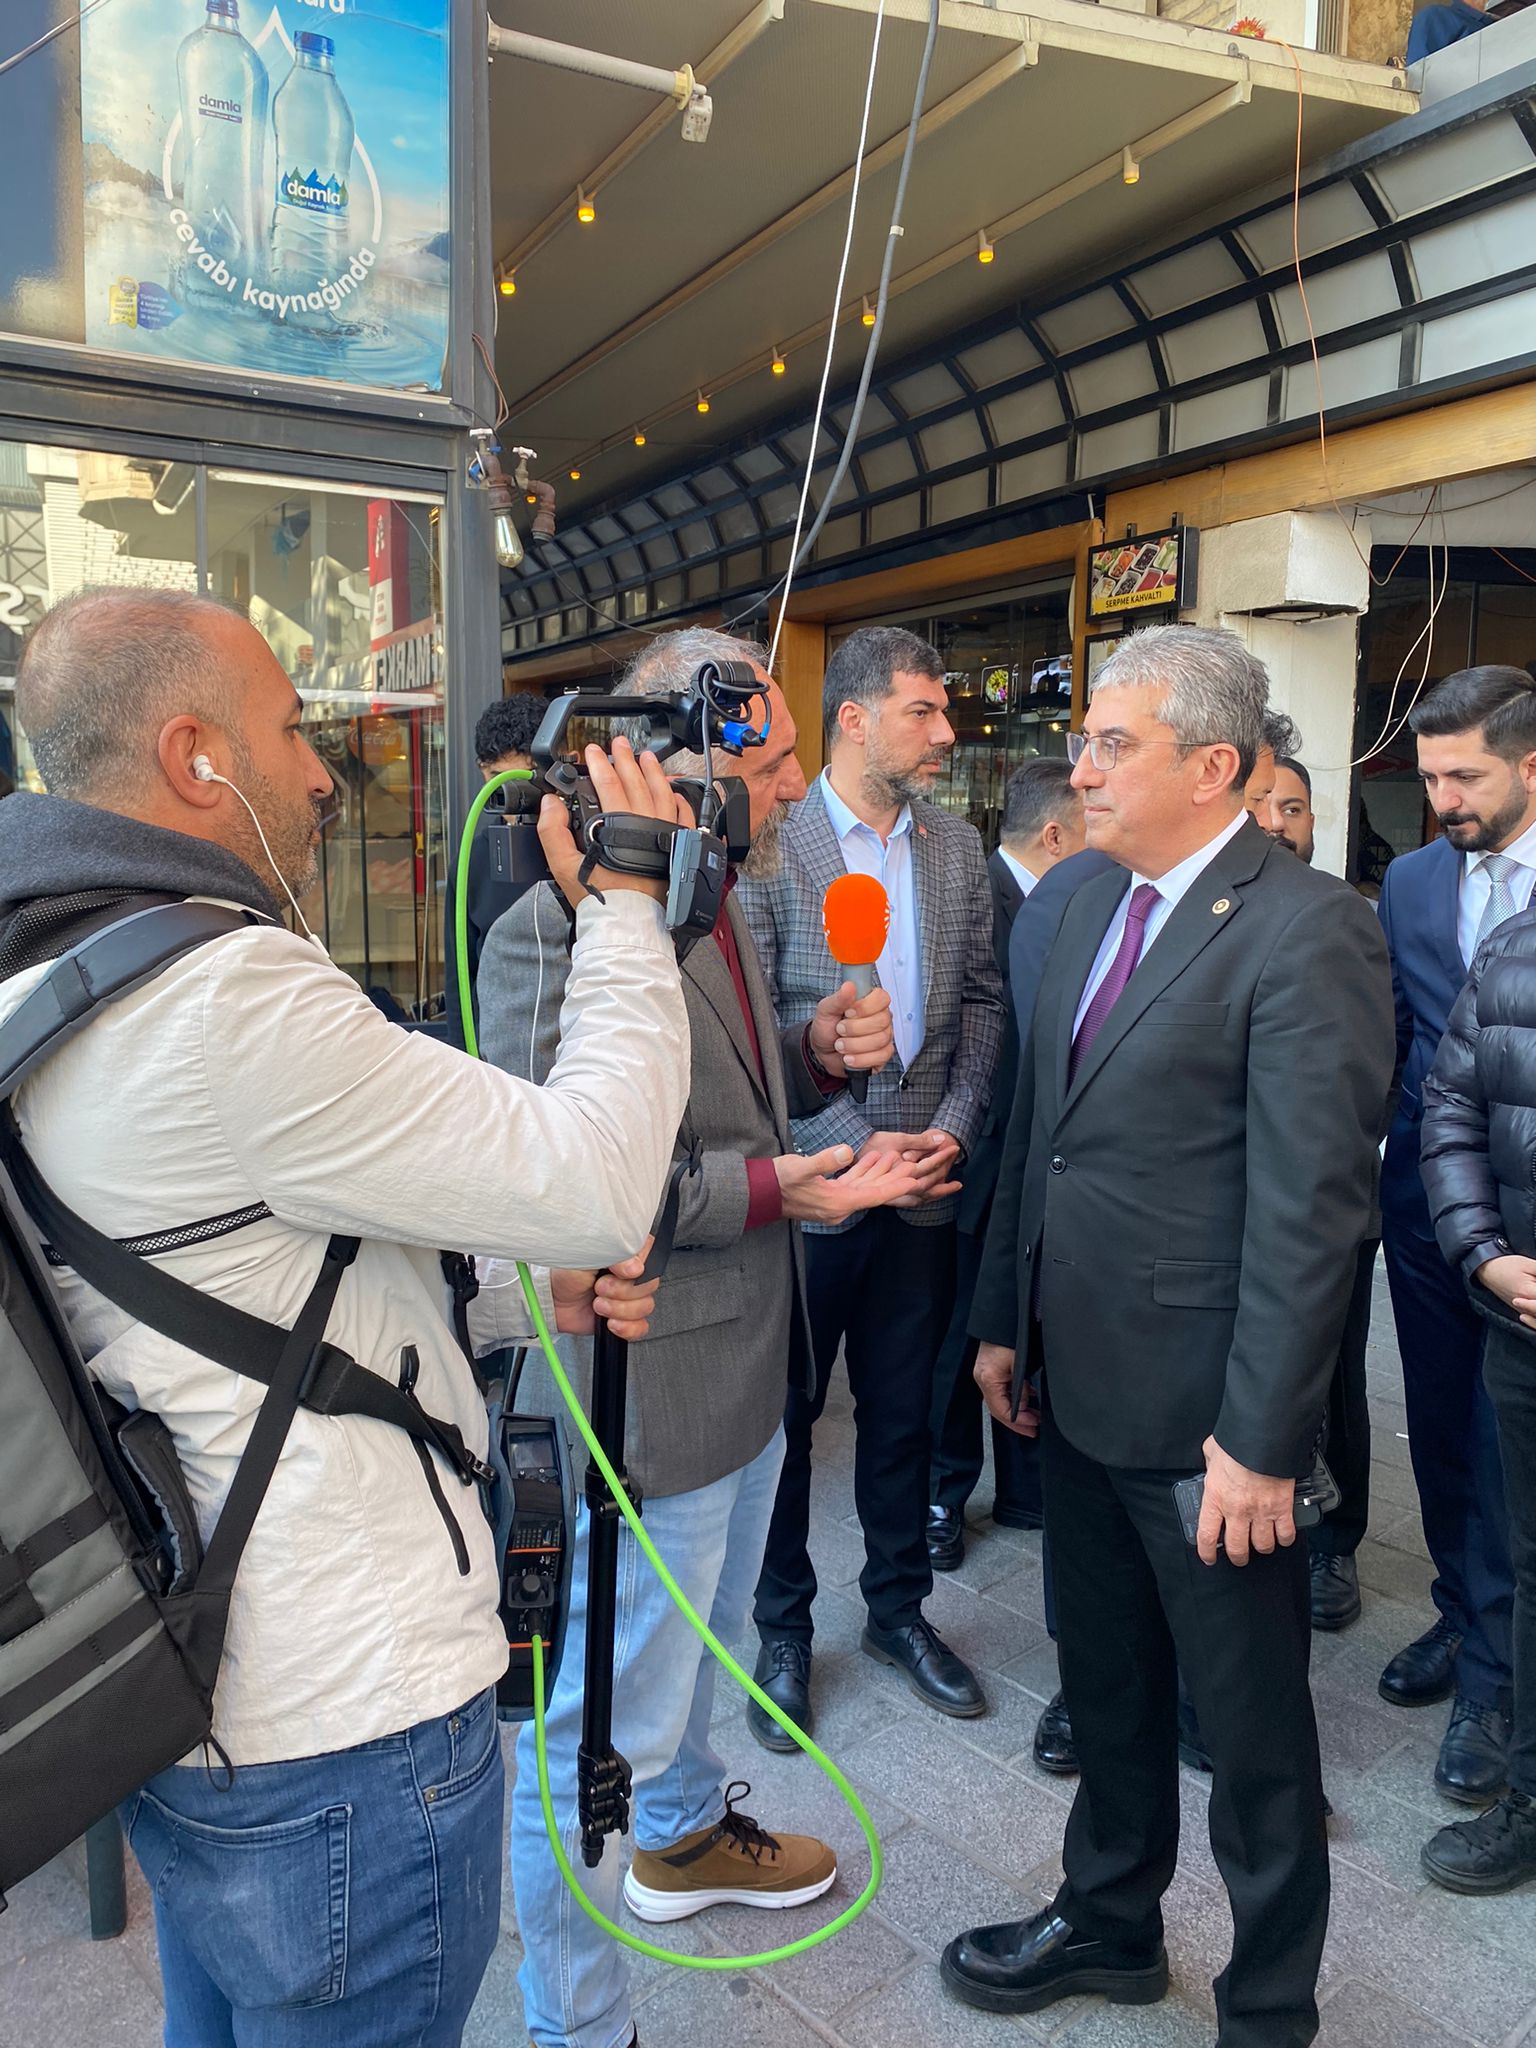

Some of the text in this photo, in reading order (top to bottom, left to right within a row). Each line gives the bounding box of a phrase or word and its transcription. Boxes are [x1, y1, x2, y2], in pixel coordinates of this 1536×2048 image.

[199, 93, 242, 113] damla
[287, 179, 341, 206] damla
[169, 208, 376, 319] cevabı kaynağında
[1105, 590, 1162, 609] SERPME KAHVALTI
